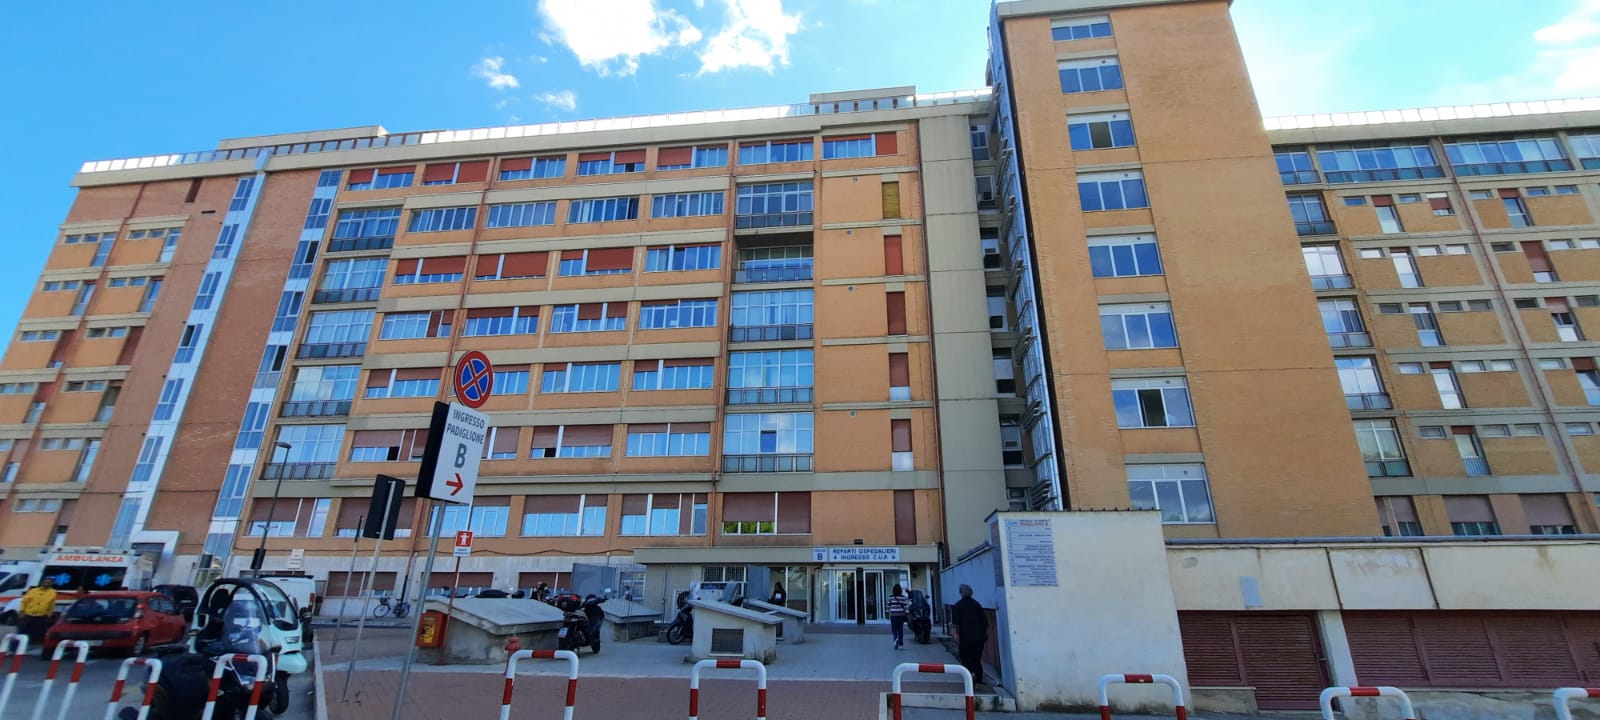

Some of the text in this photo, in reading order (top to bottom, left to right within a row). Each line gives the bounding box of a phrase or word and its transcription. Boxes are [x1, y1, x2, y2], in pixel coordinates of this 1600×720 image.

[453, 409, 485, 429] INGRESSO
[446, 423, 485, 445] PADIGLIONE
[454, 443, 467, 468] B
[56, 554, 123, 562] AMBULANZA
[817, 552, 824, 561] B
